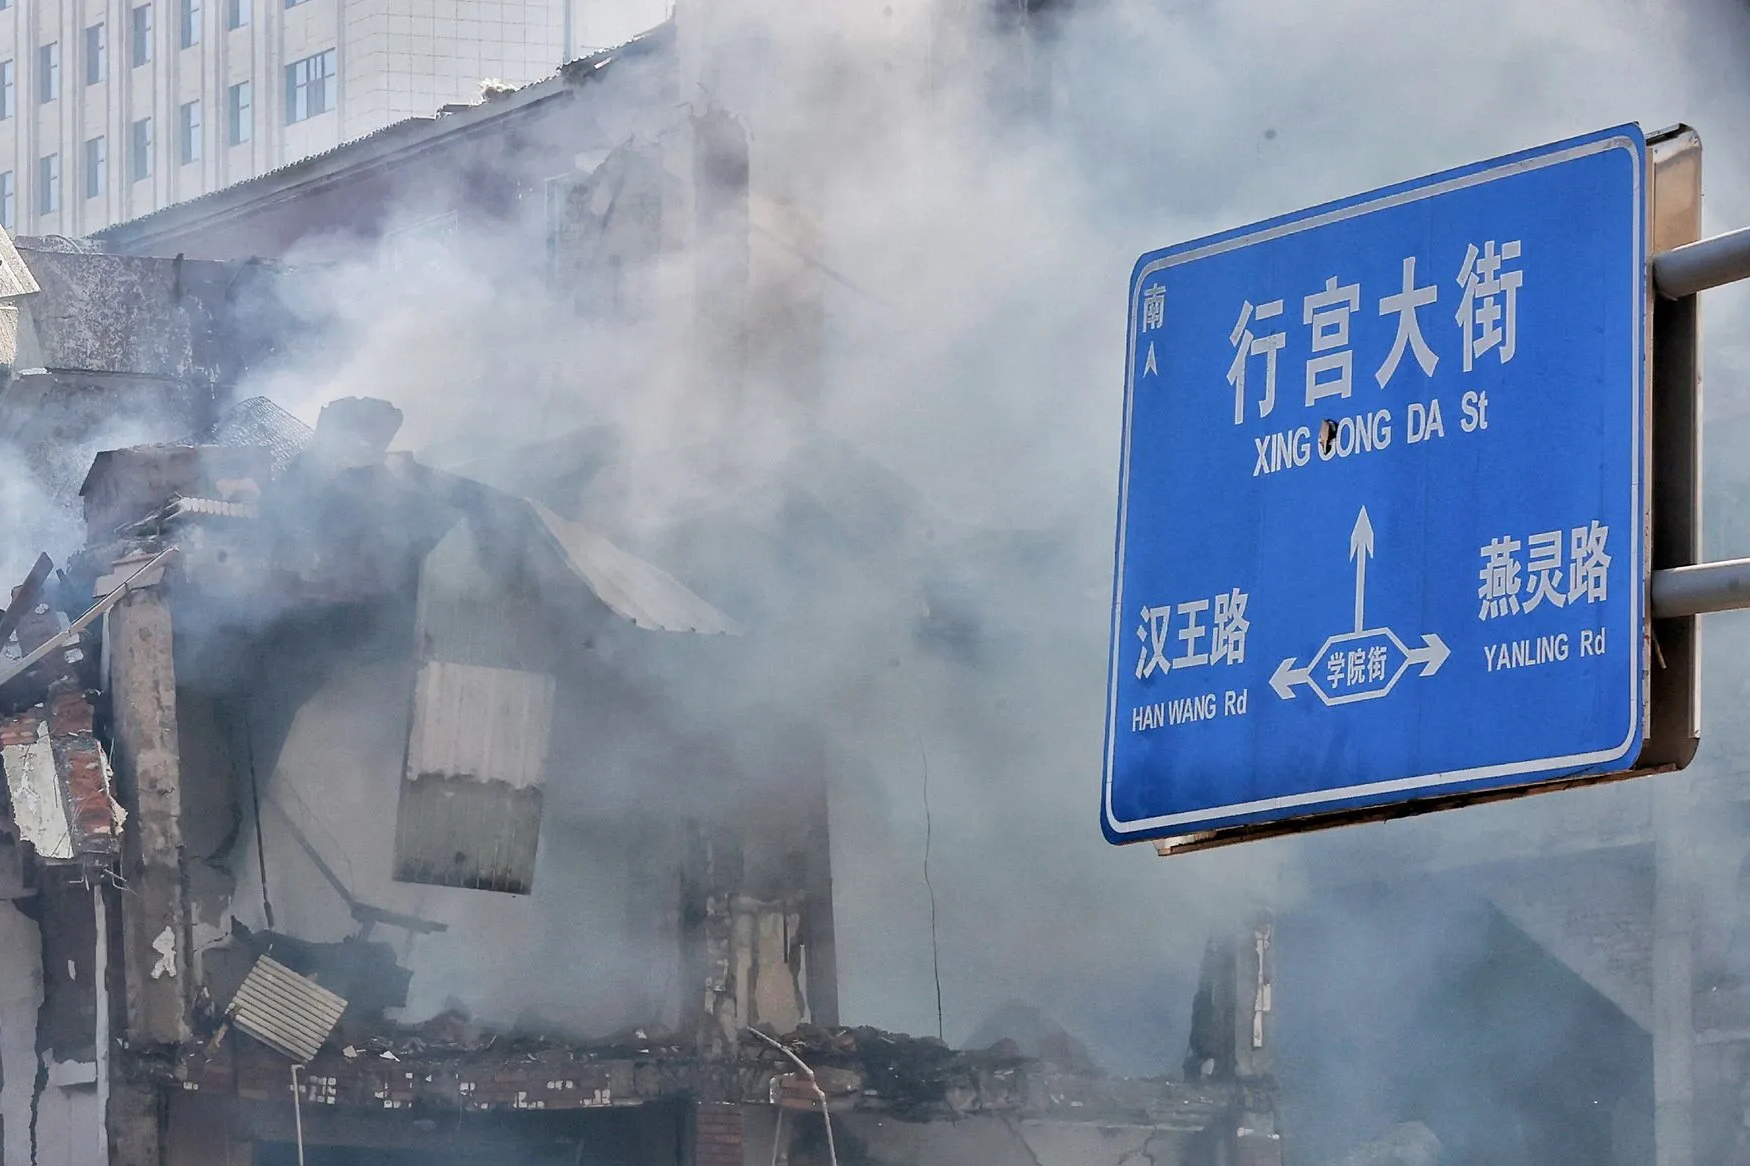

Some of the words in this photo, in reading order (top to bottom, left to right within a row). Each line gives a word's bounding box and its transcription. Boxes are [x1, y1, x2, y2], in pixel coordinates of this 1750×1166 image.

[1142, 283, 1166, 333] 南
[1226, 240, 1523, 425] 行宫大街
[1253, 426, 1311, 477] XING
[1407, 398, 1444, 444] DA
[1460, 390, 1488, 433] St
[1478, 519, 1612, 622] 燕灵路
[1134, 587, 1250, 680] 汉王路
[1326, 646, 1386, 689] 学院街
[1484, 632, 1569, 673] YANLING
[1580, 628, 1606, 657] Rd
[1225, 688, 1247, 715] Rd
